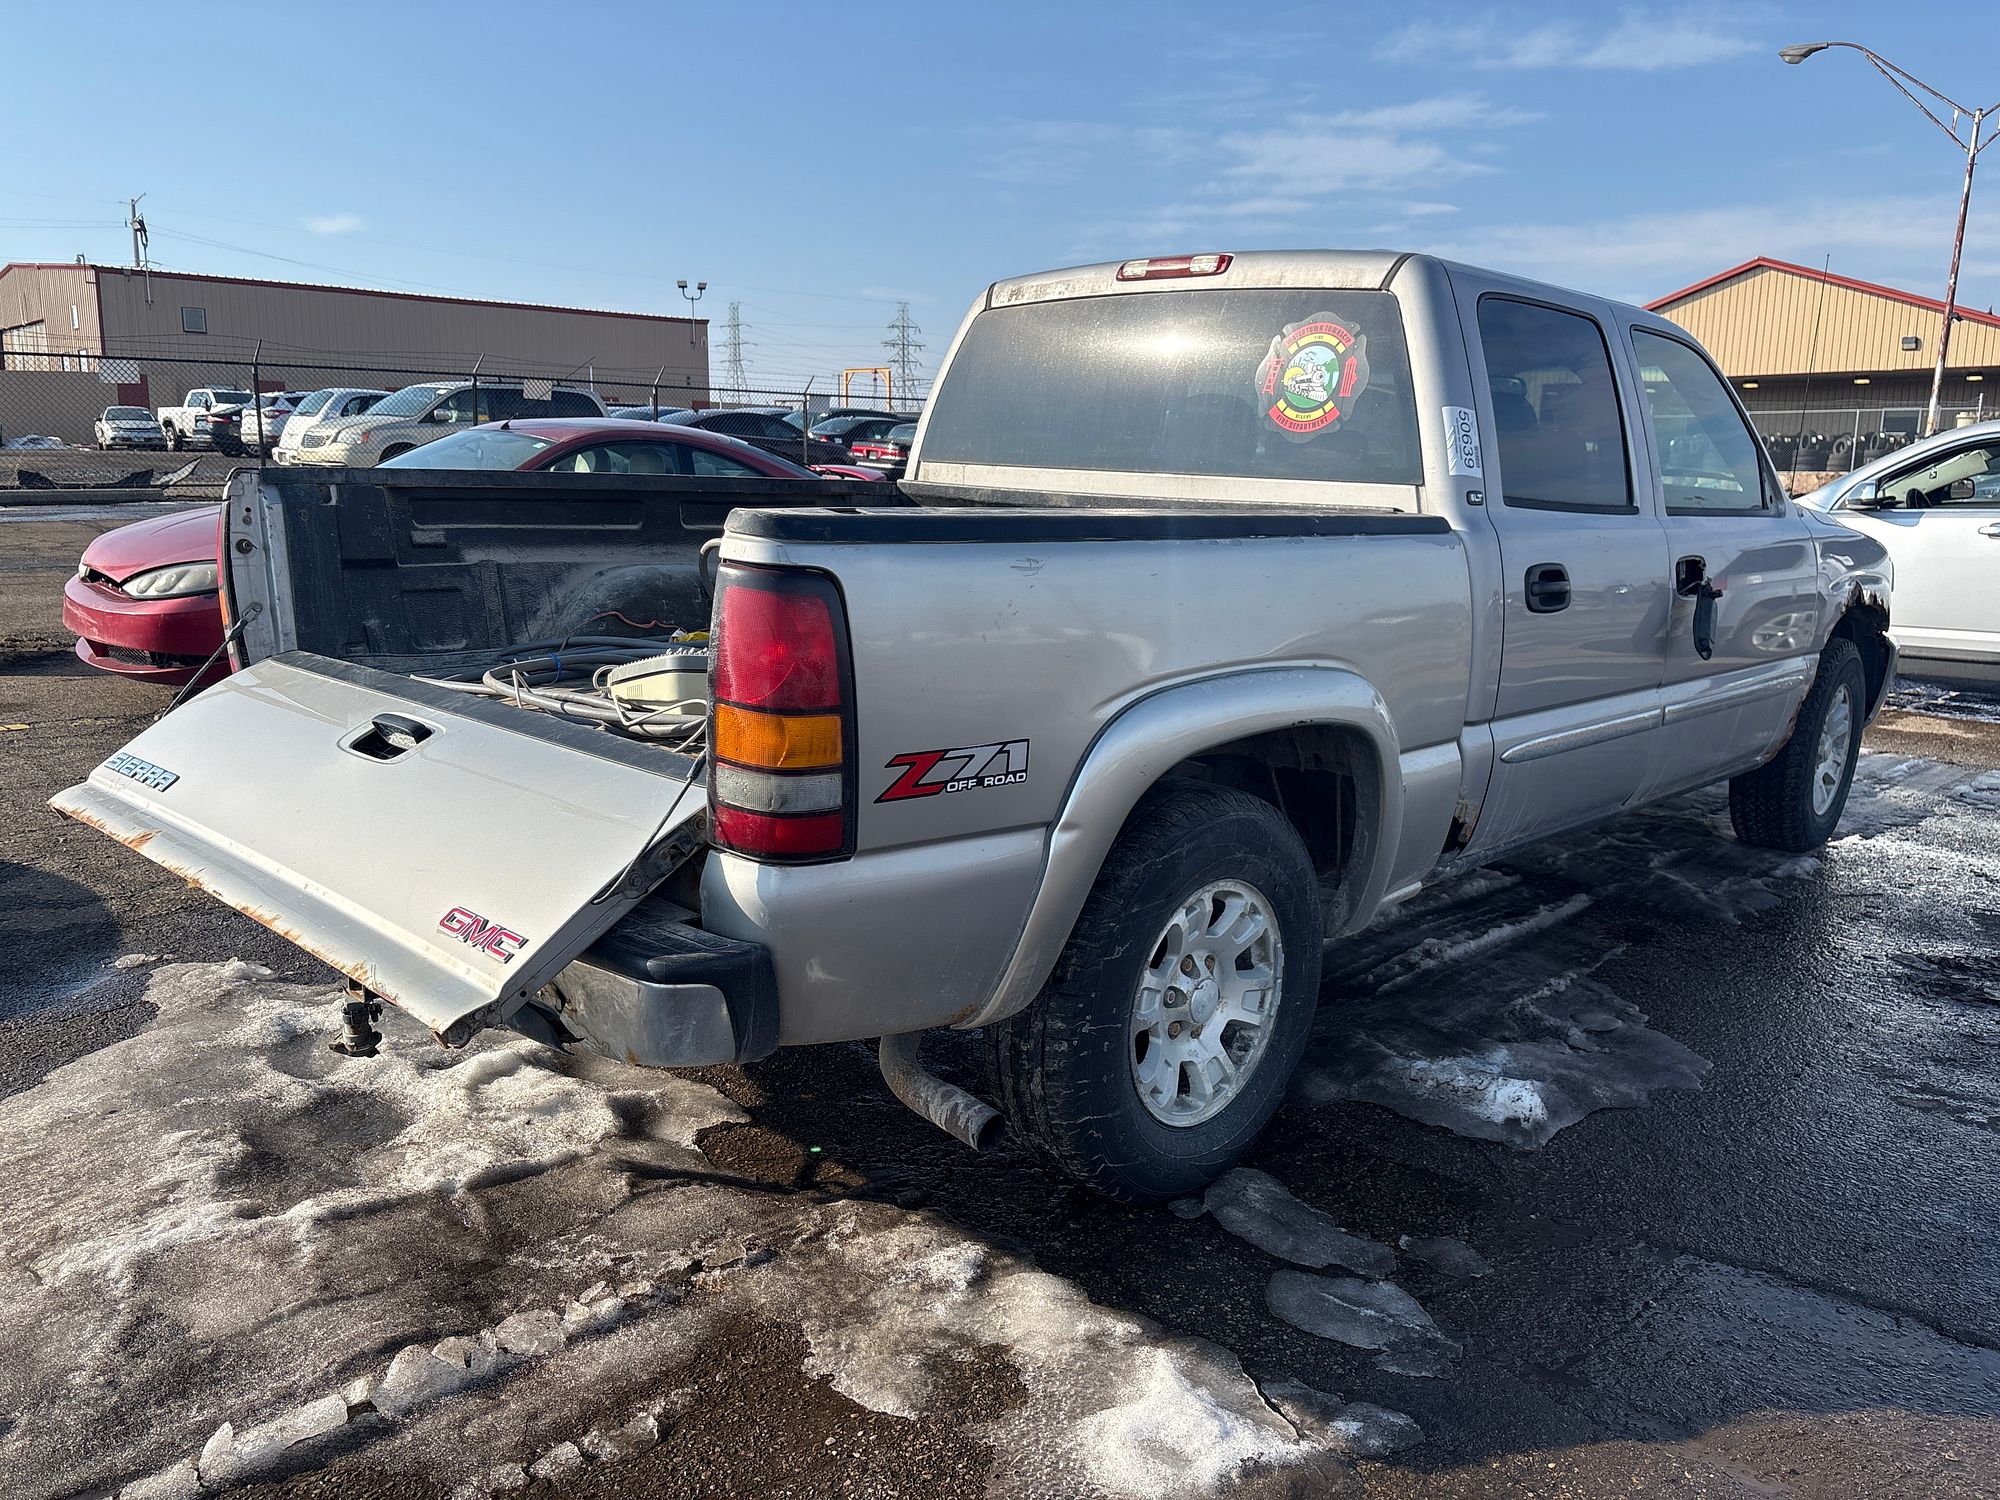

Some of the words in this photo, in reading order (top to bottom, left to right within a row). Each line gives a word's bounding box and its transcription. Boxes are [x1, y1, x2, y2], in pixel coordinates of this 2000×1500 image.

[1458, 410, 1475, 469] 50639
[103, 752, 180, 792] SIERRA
[873, 738, 1030, 804] Z71
[946, 778, 977, 793] OFF
[983, 772, 1027, 788] ROAD
[437, 906, 529, 964] GMC
